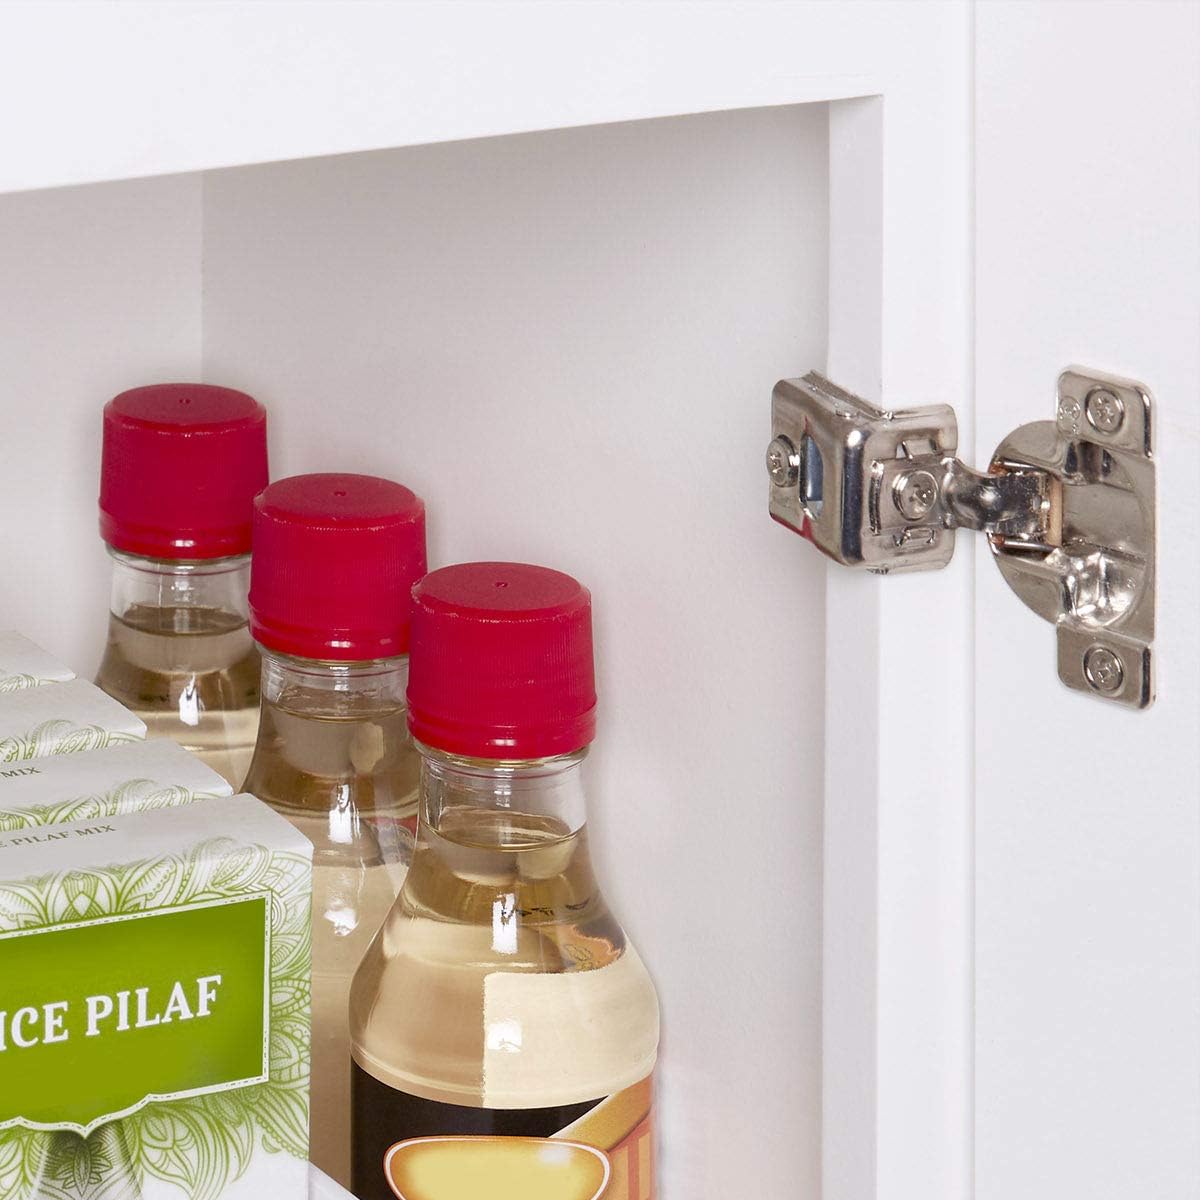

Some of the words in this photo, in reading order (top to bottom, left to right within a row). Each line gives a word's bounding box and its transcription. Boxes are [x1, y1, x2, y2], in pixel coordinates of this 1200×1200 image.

[0, 766, 41, 778] MIX
[12, 831, 69, 847] PILAF
[76, 824, 116, 837] MIX
[85, 974, 222, 1036] PILAF
